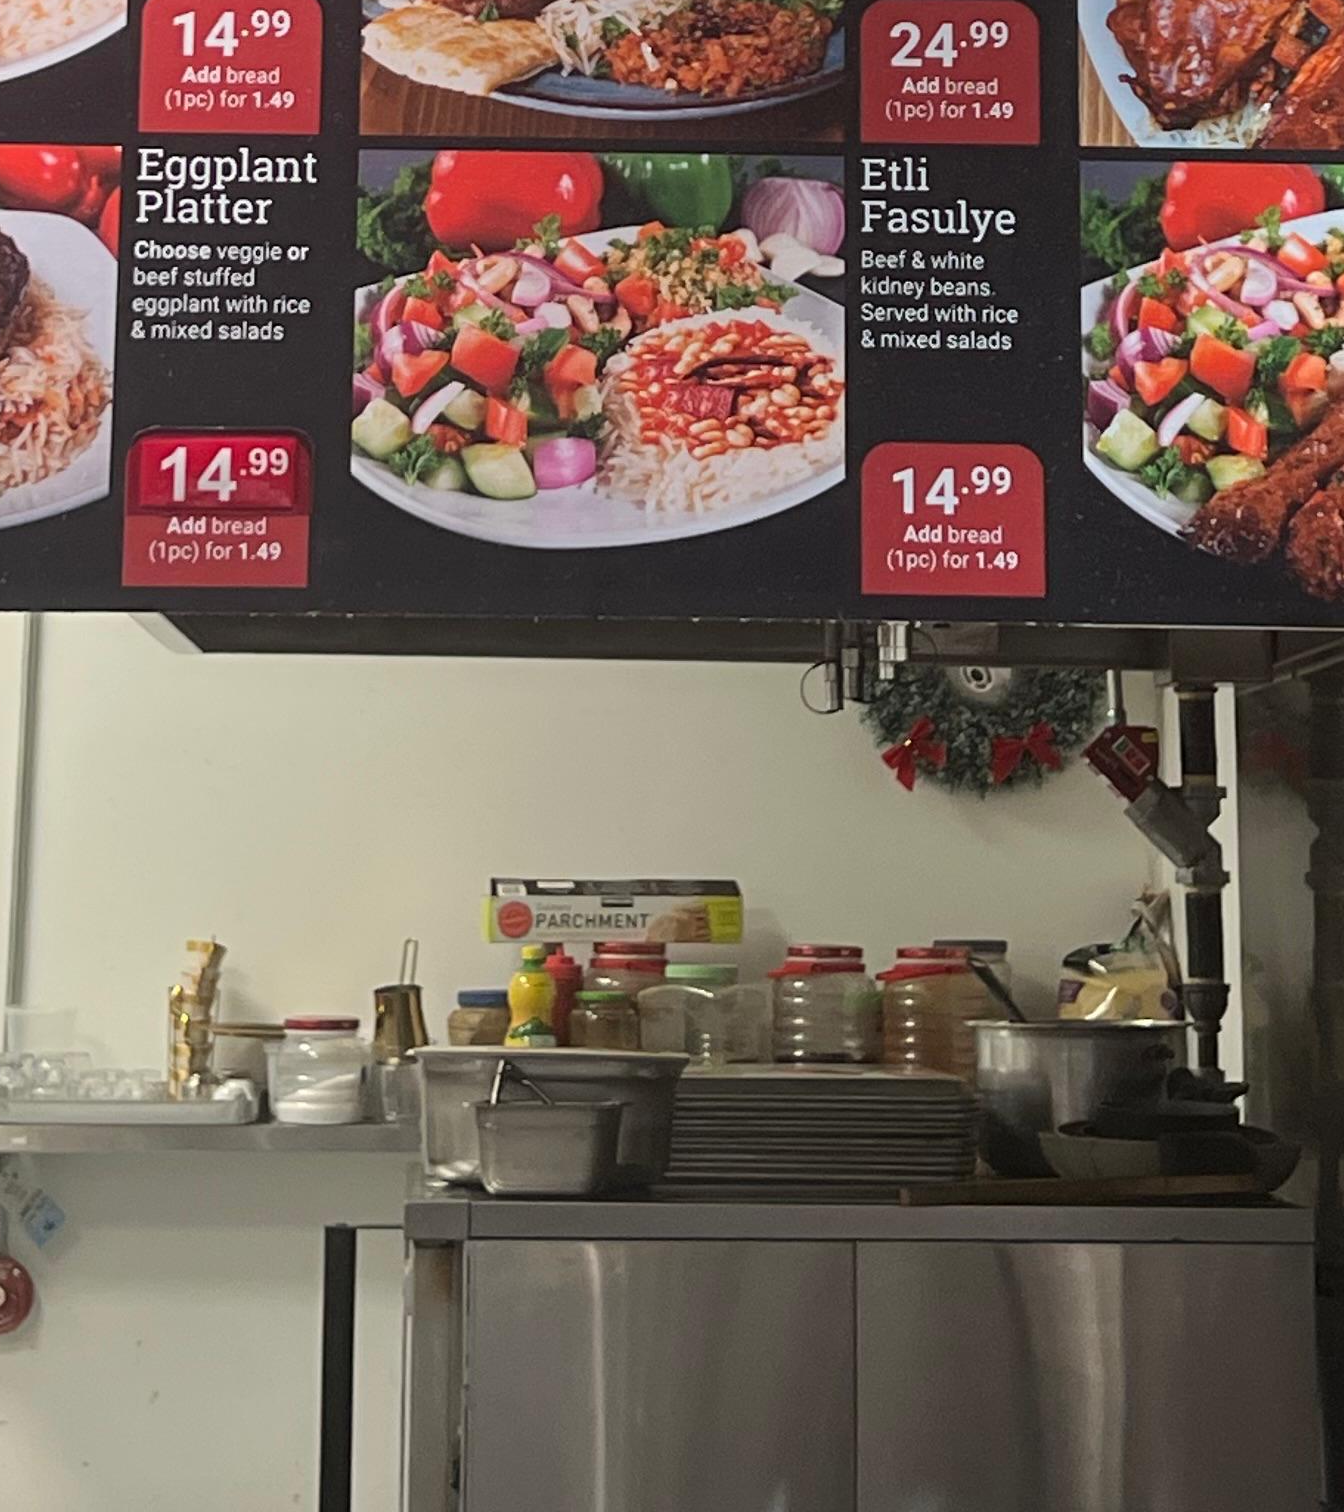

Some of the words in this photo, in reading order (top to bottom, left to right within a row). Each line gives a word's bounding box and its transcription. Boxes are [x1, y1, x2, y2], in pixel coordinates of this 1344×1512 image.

[172, 9, 291, 57] 14.99
[889, 20, 1009, 68] 24.99
[136, 147, 318, 191] Eggplant
[860, 156, 930, 192] Etli
[135, 189, 273, 225] Platter
[860, 199, 1016, 243] Fasulye
[861, 249, 907, 269] Beef
[911, 250, 926, 270] &
[930, 250, 985, 271] white
[860, 275, 925, 301] kidney
[930, 276, 996, 297] beans.
[860, 302, 929, 323] Served
[934, 303, 977, 323] with
[981, 305, 1019, 324] rice
[860, 328, 876, 349] &
[880, 330, 941, 349] mixed
[946, 330, 1012, 351] salads
[160, 446, 289, 502] 14.99
[892, 465, 1012, 516] 14.99
[903, 524, 943, 544] Add
[947, 524, 1003, 545] bread
[886, 548, 937, 572] (1pc)
[942, 549, 970, 569] for
[975, 551, 1018, 570] 1.49
[535, 912, 650, 929] PARCHMENT
